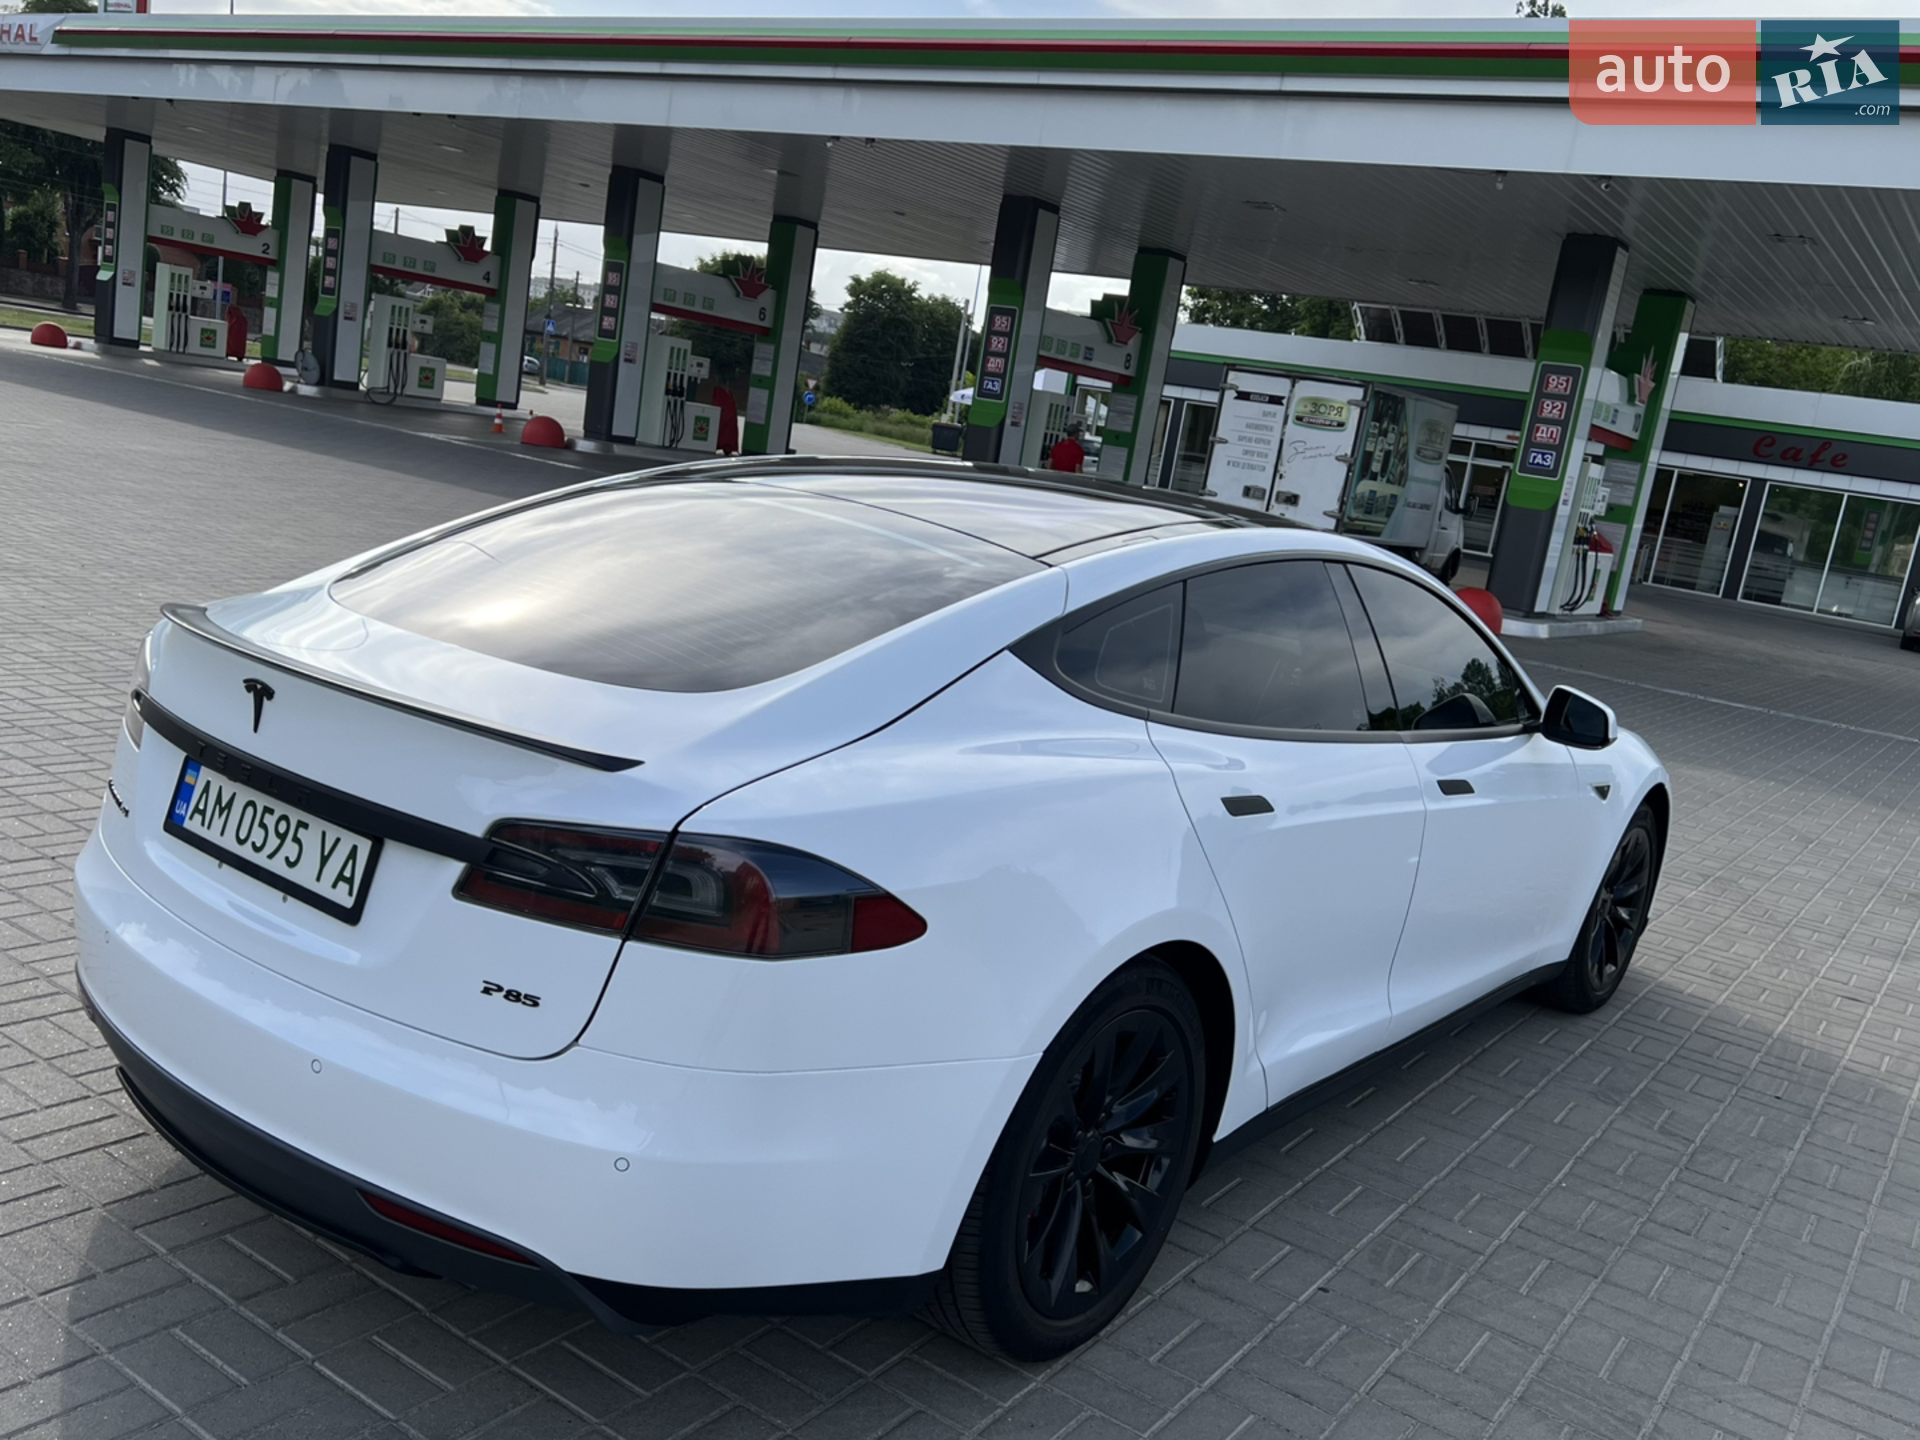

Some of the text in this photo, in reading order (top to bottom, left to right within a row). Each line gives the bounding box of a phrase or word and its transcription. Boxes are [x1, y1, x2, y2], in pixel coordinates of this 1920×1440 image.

[261, 243, 271, 255] 2
[482, 271, 491, 284] 4
[757, 307, 767, 321] 6
[994, 315, 1008, 328] 95
[991, 336, 1005, 348] 92
[1123, 353, 1133, 370] 8
[1548, 375, 1567, 389] 95
[1309, 402, 1345, 418] ЗОРЯ
[1543, 400, 1562, 414] 92
[1536, 426, 1557, 438] ДП
[1752, 435, 1849, 468] Cafe
[1528, 452, 1552, 466] ГАЗ
[175, 799, 188, 817] UA
[188, 779, 237, 837] AM
[235, 799, 310, 869] 0595
[315, 830, 359, 898] YA
[480, 980, 542, 1008] P85
